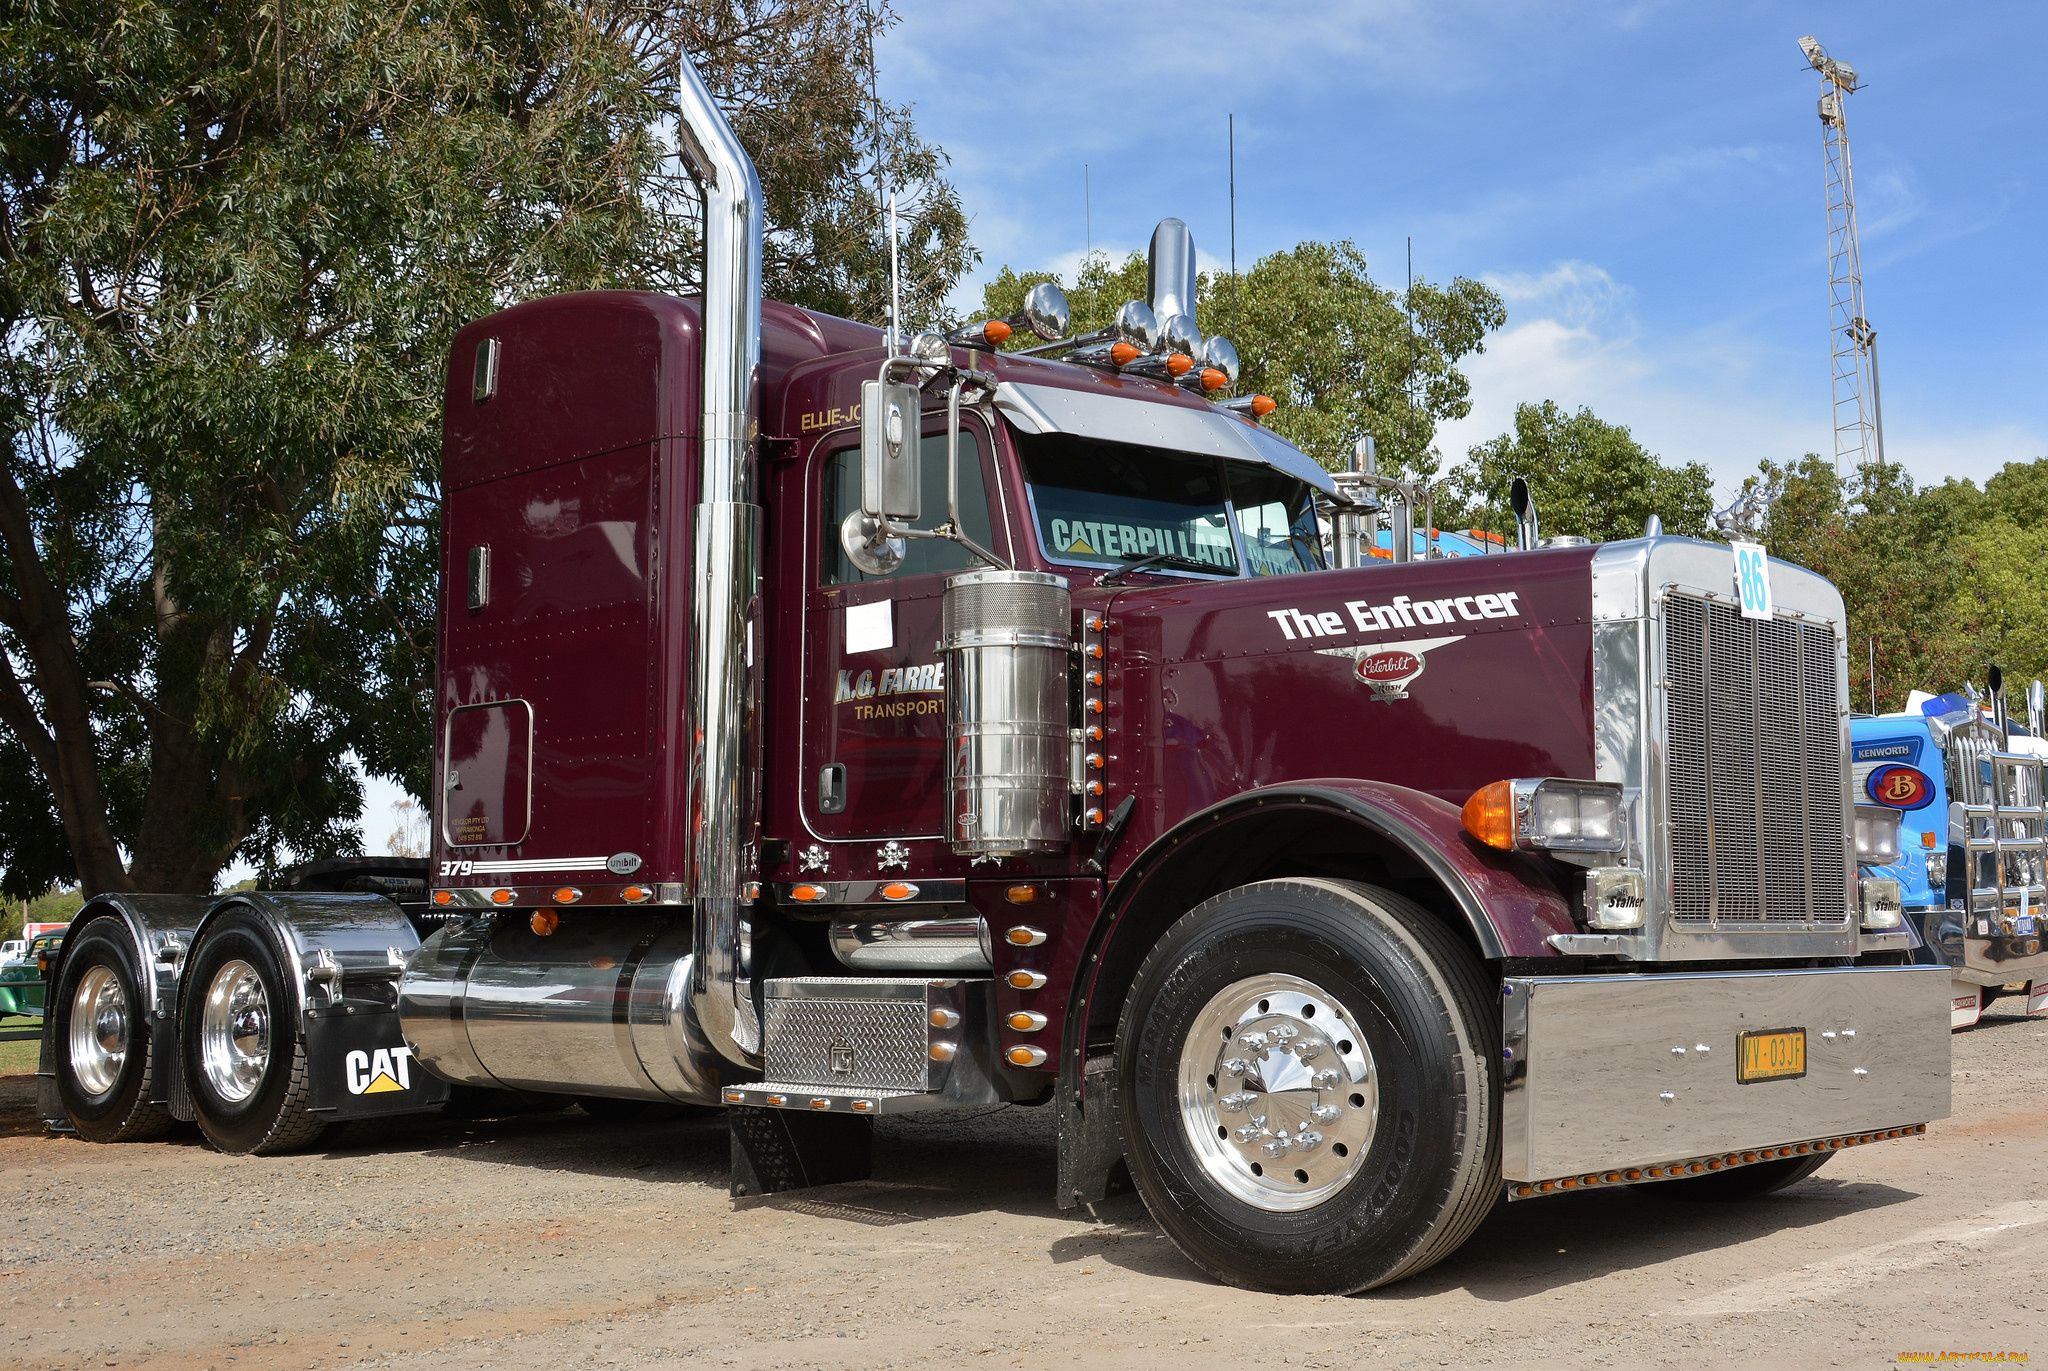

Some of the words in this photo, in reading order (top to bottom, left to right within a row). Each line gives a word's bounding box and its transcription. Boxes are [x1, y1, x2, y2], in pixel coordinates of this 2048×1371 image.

[1051, 517, 1233, 572] CATERPILLAR
[1738, 549, 1766, 613] 86
[1267, 608, 1347, 641] The
[1344, 591, 1520, 633] Enforcer
[1363, 656, 1413, 676] Peterbilt
[834, 669, 877, 705] K.G.
[1858, 745, 1909, 759] KENWORTH
[1885, 775, 1917, 800] B
[439, 861, 473, 876] 379
[610, 857, 637, 867] unibilt
[1608, 896, 1644, 908] Stalker
[1875, 900, 1901, 911] Stalker
[345, 1046, 413, 1095] CAT
